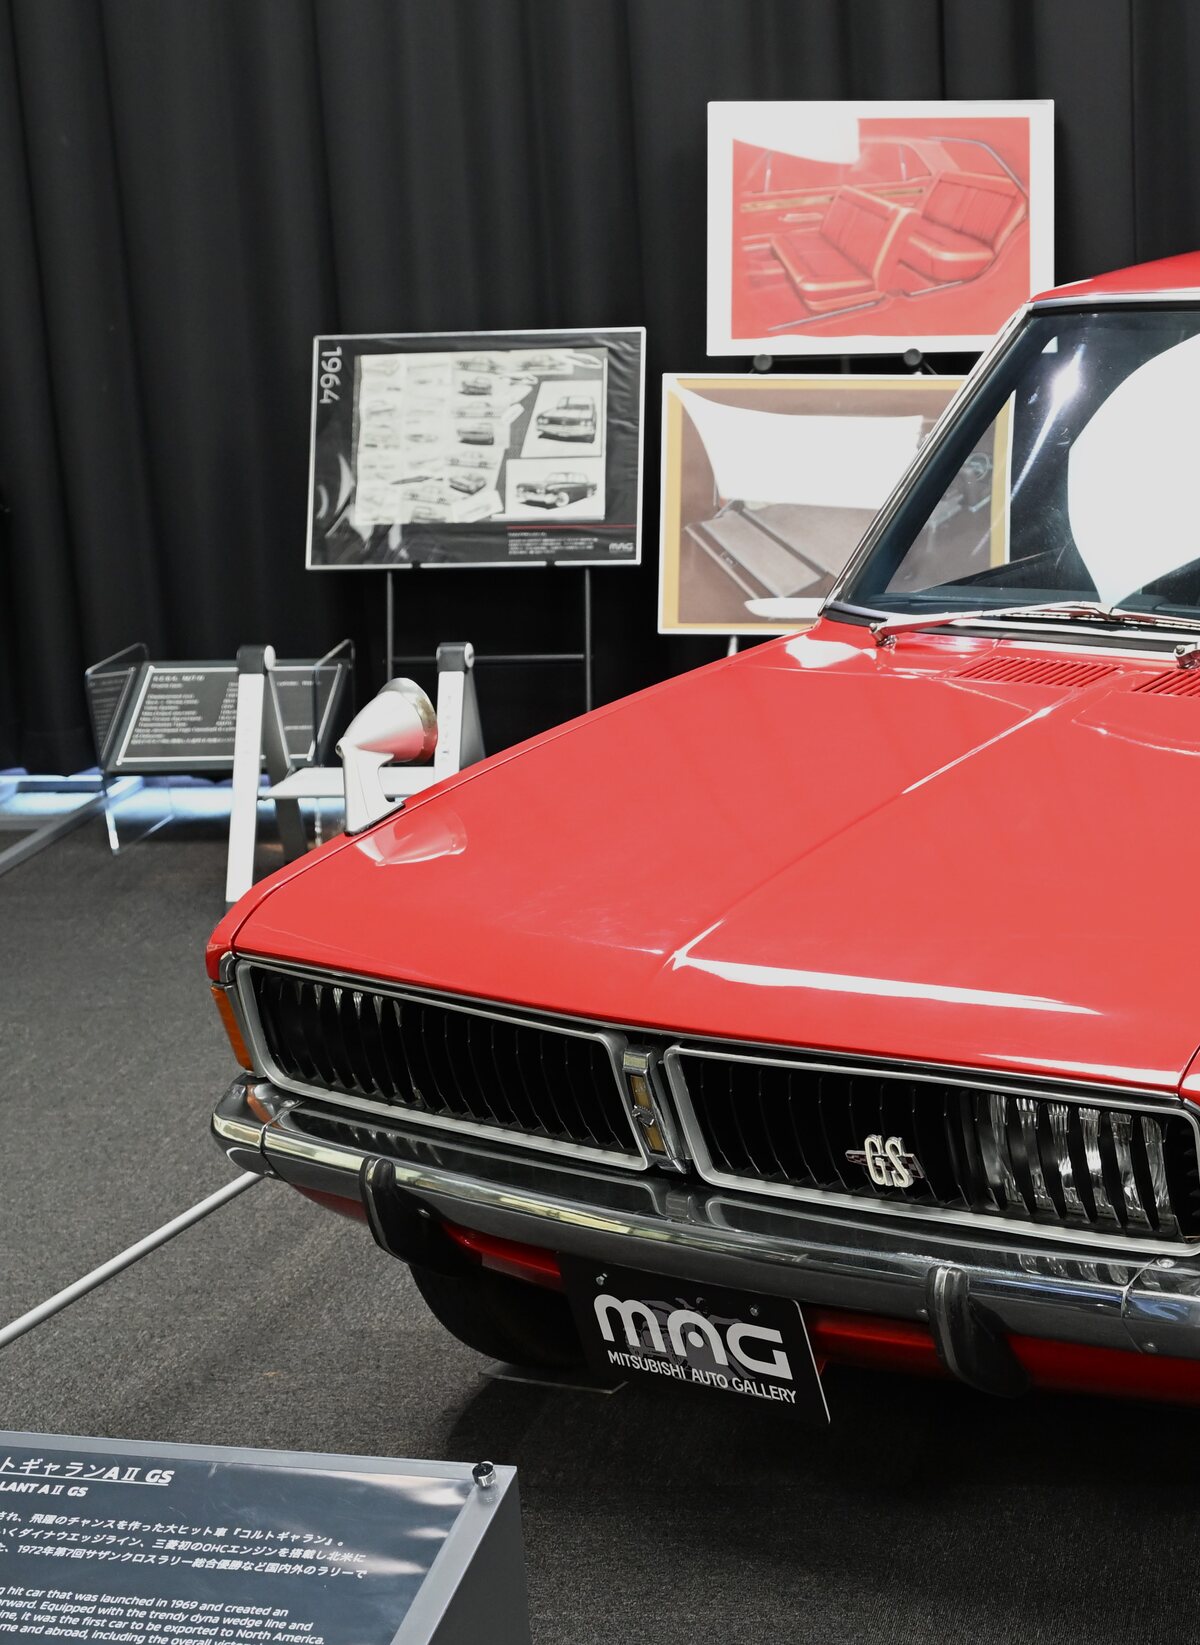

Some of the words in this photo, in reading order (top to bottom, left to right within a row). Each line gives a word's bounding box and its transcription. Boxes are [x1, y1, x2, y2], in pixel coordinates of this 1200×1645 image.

[320, 346, 342, 404] 1964
[864, 1134, 914, 1188] GS
[607, 1350, 687, 1380] MITSUBISHI
[691, 1369, 729, 1389] AUTO
[732, 1377, 797, 1404] GALLERY
[67, 1486, 89, 1497] GS
[145, 1469, 175, 1484] GS
[0, 1599, 37, 1609] rward.
[40, 1601, 97, 1615] Equipped
[98, 1606, 124, 1616] with
[126, 1608, 146, 1618] the
[149, 1610, 188, 1622] trendy
[190, 1613, 220, 1624] dyna
[222, 1616, 262, 1628] wedge
[264, 1619, 287, 1629] line
[289, 1622, 313, 1631] and
[7, 1586, 24, 1596] hit
[26, 1589, 46, 1597] car
[47, 1590, 73, 1600] that
[75, 1593, 98, 1601] was
[100, 1594, 155, 1606] launched
[156, 1599, 168, 1607] in
[171, 1600, 198, 1609] 1969
[199, 1603, 223, 1612] and
[224, 1604, 272, 1616] created
[272, 1609, 289, 1617] an
[19, 1624, 43, 1634] and
[44, 1626, 88, 1639] abroad,
[91, 1630, 145, 1645] including
[148, 1635, 169, 1645] the
[21, 1611, 31, 1621] it
[33, 1614, 57, 1623] was
[59, 1614, 80, 1625] the
[81, 1617, 108, 1627] first
[108, 1620, 128, 1629] car
[130, 1621, 144, 1631] to
[145, 1622, 162, 1632] be
[163, 1625, 220, 1637] exported
[220, 1628, 233, 1637] to
[235, 1630, 271, 1641] North
[273, 1633, 325, 1645] America.
